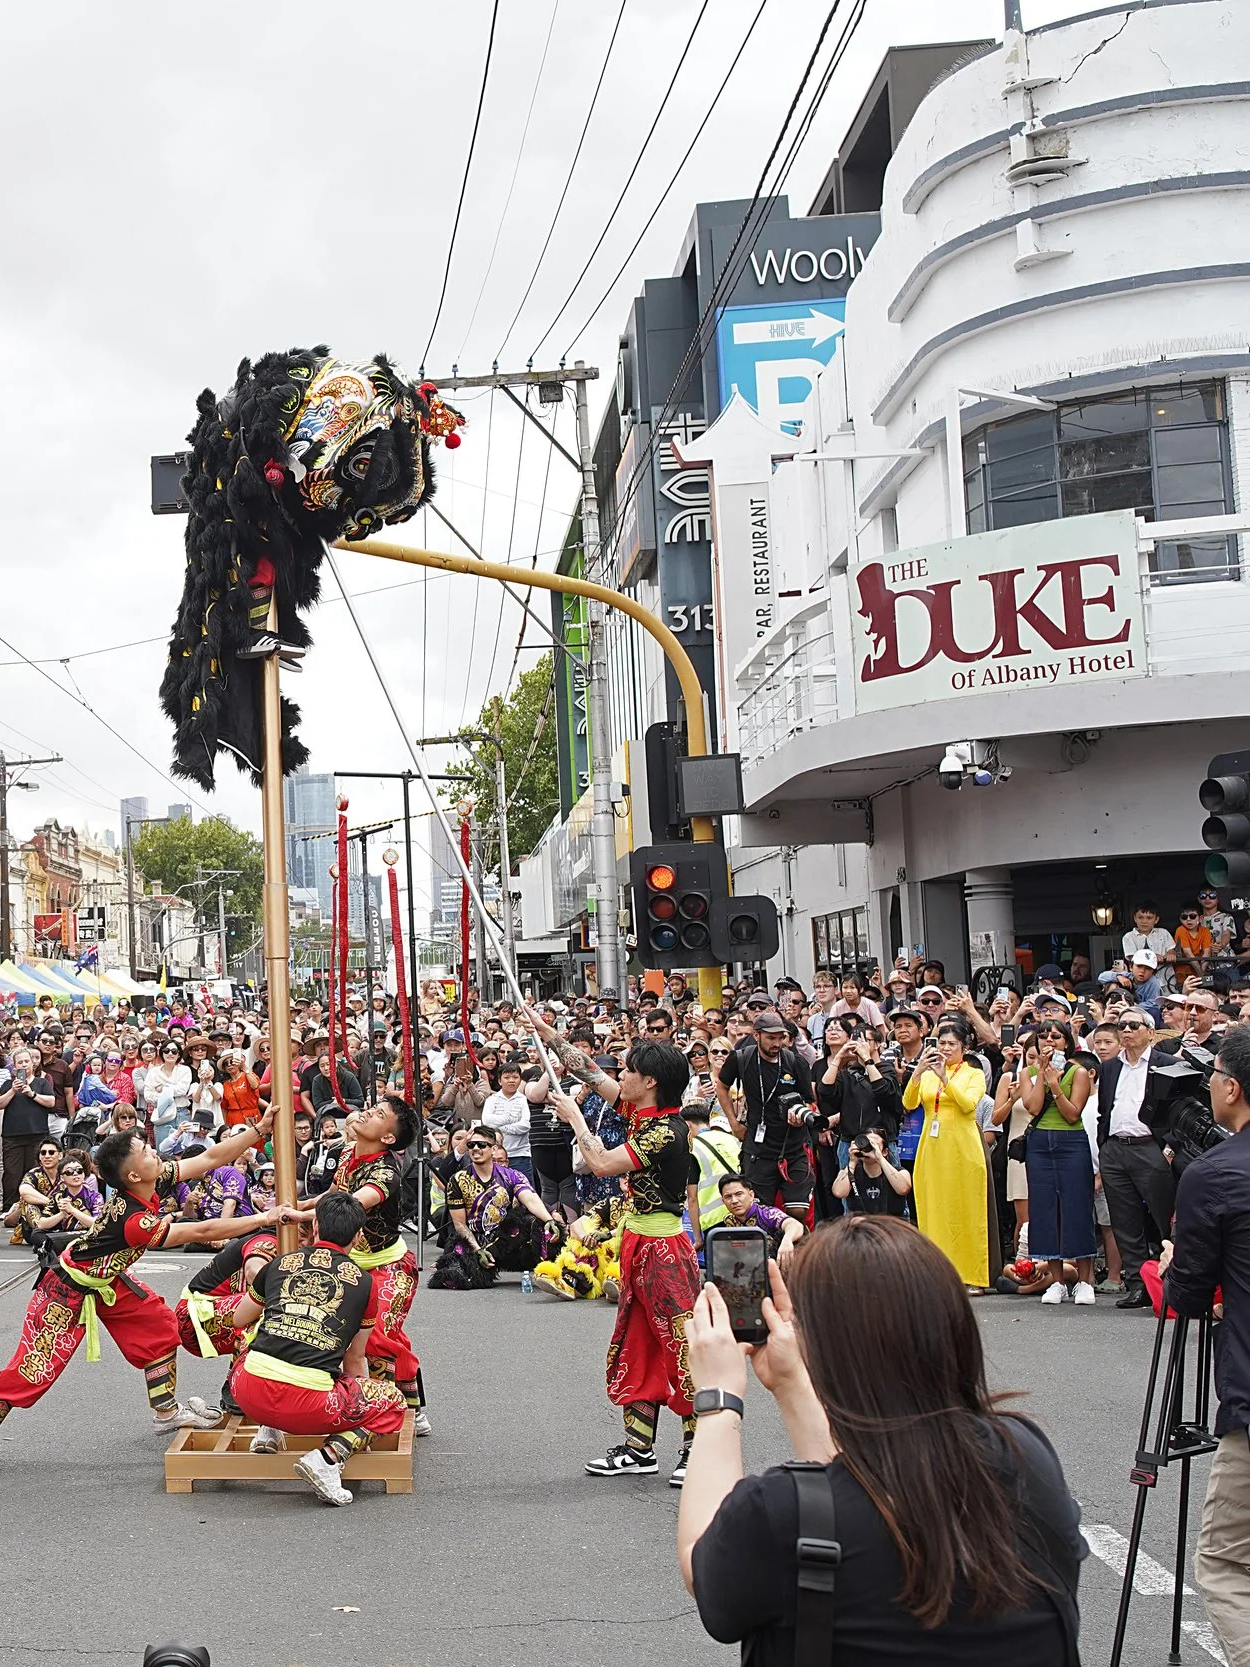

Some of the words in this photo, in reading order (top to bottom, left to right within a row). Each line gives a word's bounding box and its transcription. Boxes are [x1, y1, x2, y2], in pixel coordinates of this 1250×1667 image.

[769, 322, 805, 338] HIVE
[750, 499, 770, 594] RESTAURANT
[888, 559, 929, 583] THE
[858, 554, 1132, 683] DUKE
[951, 669, 977, 690] Of
[982, 662, 1061, 688] Albany
[1069, 650, 1135, 675] Hotel
[284, 1315, 321, 1331] MELBOURNE
